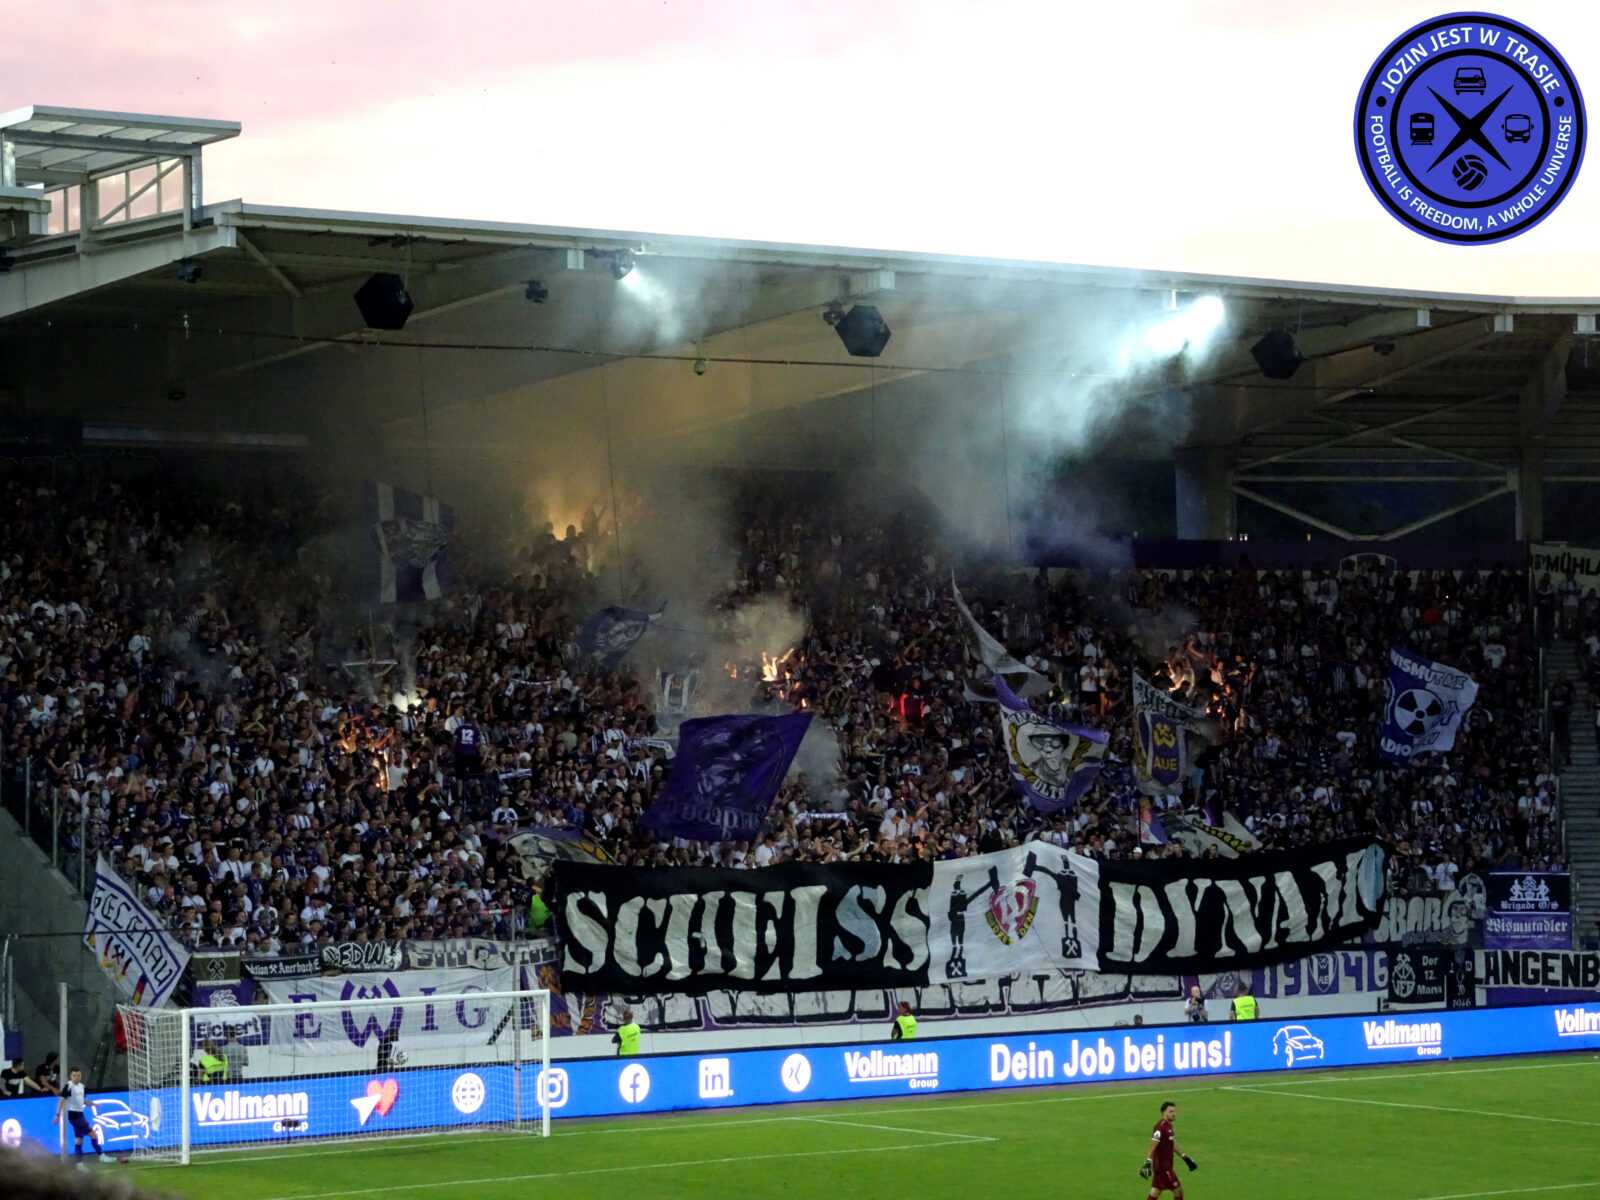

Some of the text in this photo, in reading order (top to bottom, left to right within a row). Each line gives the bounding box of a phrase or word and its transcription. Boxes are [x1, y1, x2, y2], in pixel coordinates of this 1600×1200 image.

[461, 729, 474, 741] 12
[1153, 757, 1177, 770] AUE
[1500, 900, 1535, 911] Brigade
[1486, 918, 1568, 932] Wismutadler
[562, 885, 931, 981] SCHEISS
[1422, 955, 1440, 967] Der
[288, 977, 489, 1047] EWIG
[1363, 1020, 1441, 1045] Vollmann
[991, 1031, 1231, 1081] Dein Job bei uns!
[1417, 1047, 1441, 1056] Group
[844, 1050, 938, 1077] Vollmann
[909, 1079, 938, 1088] Group
[193, 1091, 308, 1121] Vollmann
